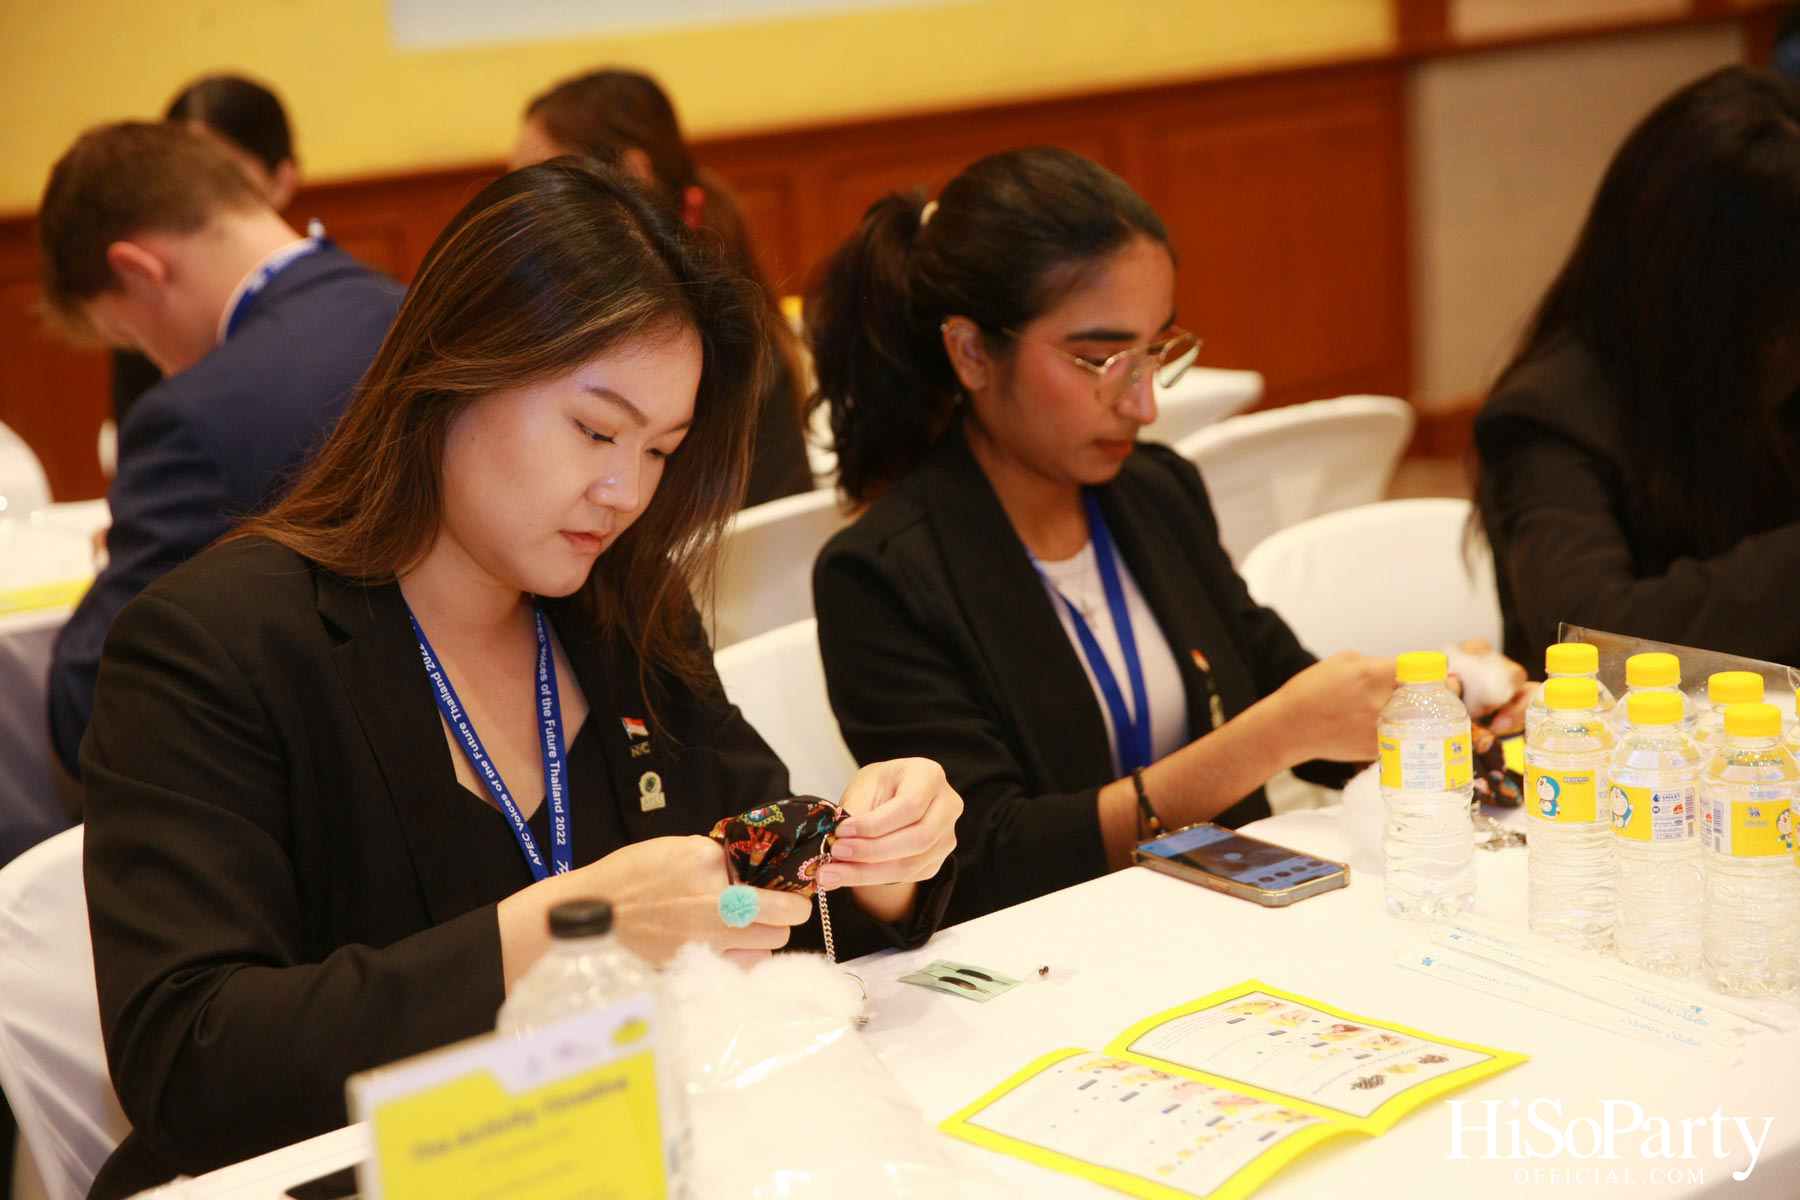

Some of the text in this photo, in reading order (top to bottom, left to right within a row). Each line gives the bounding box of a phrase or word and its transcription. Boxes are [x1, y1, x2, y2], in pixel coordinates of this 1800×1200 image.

[430, 671, 462, 722] Thailand
[540, 683, 552, 695] of
[541, 697, 553, 717] the
[459, 722, 483, 760] Future
[544, 719, 558, 759] Future
[481, 760, 496, 779] the
[491, 779, 503, 792] of
[550, 760, 564, 814] Thailand
[501, 793, 525, 832] Voices
[555, 816, 566, 845] 2022
[521, 832, 542, 867] APEC
